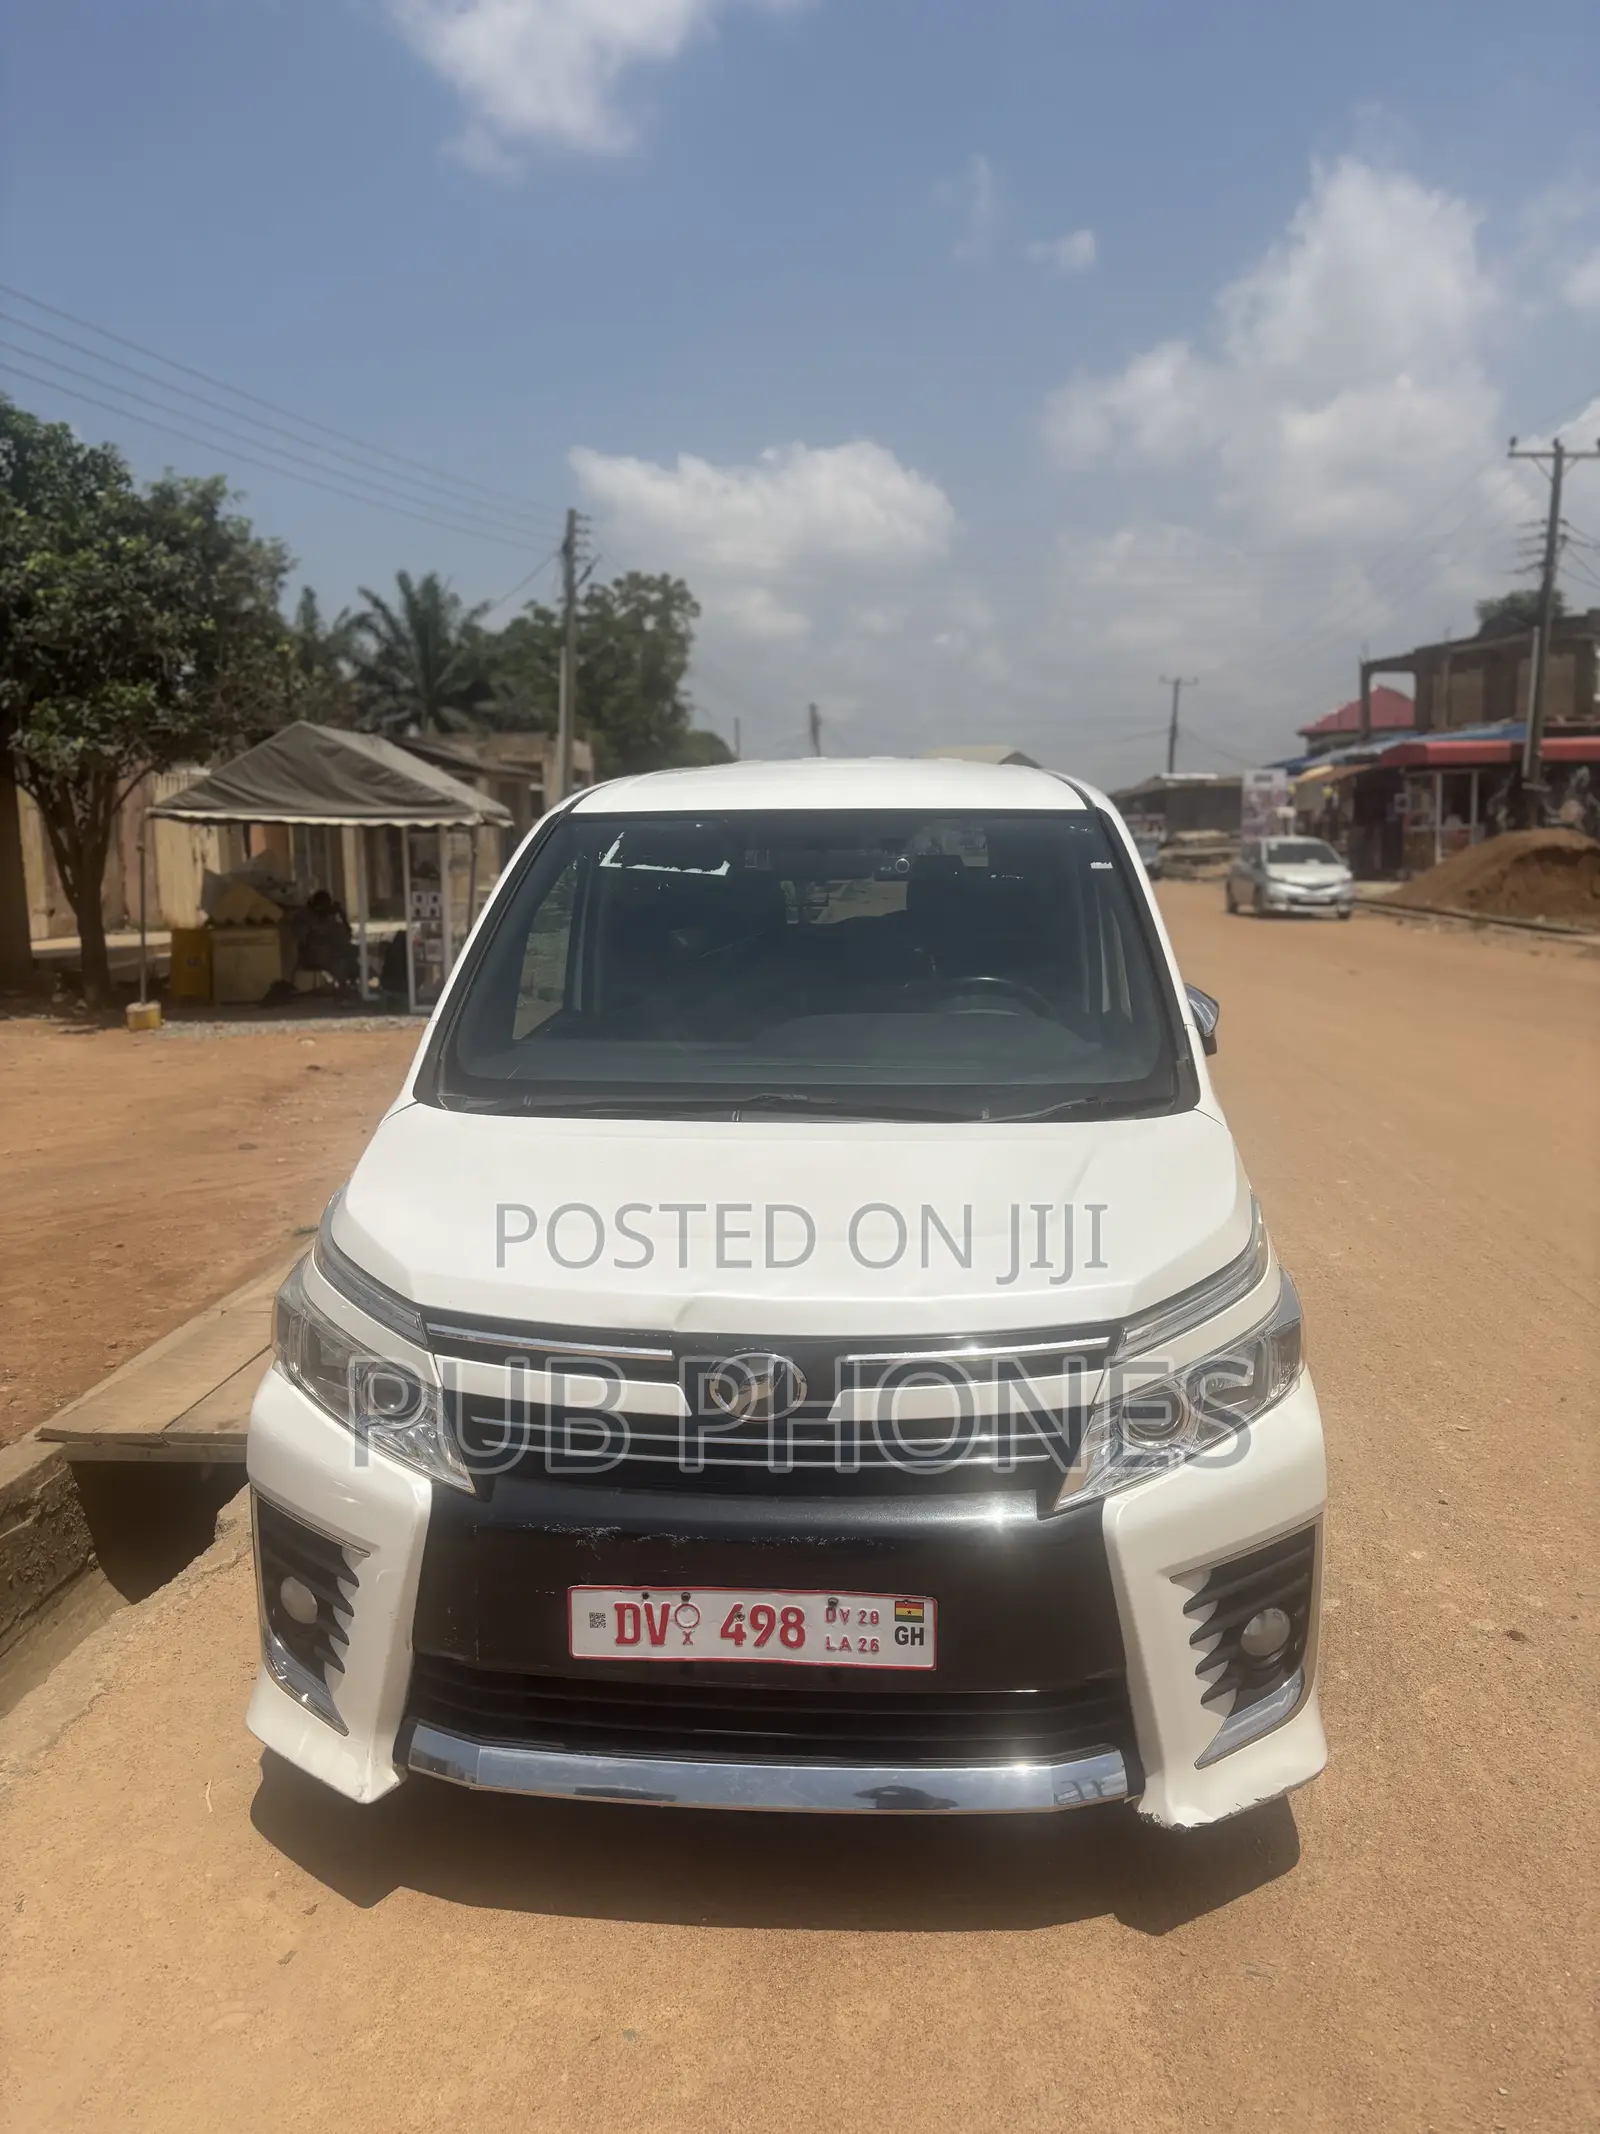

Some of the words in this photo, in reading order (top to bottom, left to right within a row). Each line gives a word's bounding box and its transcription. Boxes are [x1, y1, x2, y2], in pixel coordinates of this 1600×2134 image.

[613, 1602, 671, 1646] DV
[720, 1603, 806, 1650] 498
[894, 1625, 925, 1646] GH
[825, 1635, 852, 1652] LA
[858, 1637, 880, 1653] 26
